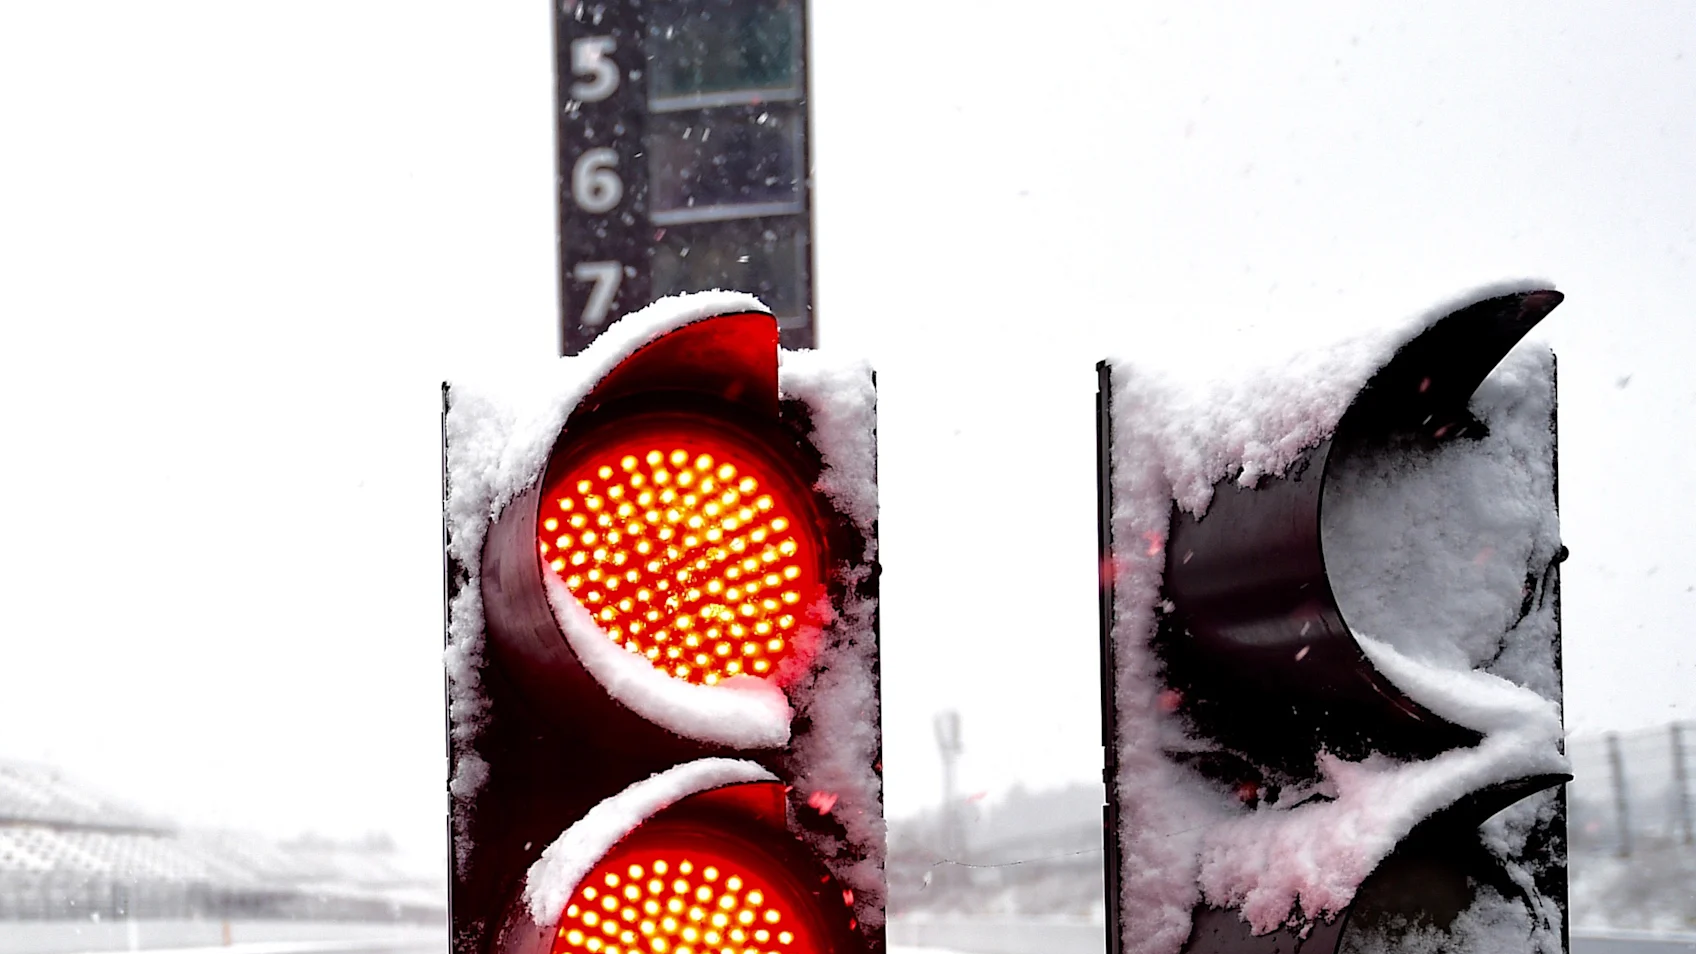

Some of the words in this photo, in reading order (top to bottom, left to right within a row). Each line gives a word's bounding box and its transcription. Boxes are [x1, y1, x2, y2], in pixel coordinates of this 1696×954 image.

[570, 35, 620, 102] 5
[571, 147, 624, 214] 6
[573, 260, 623, 326] 7
